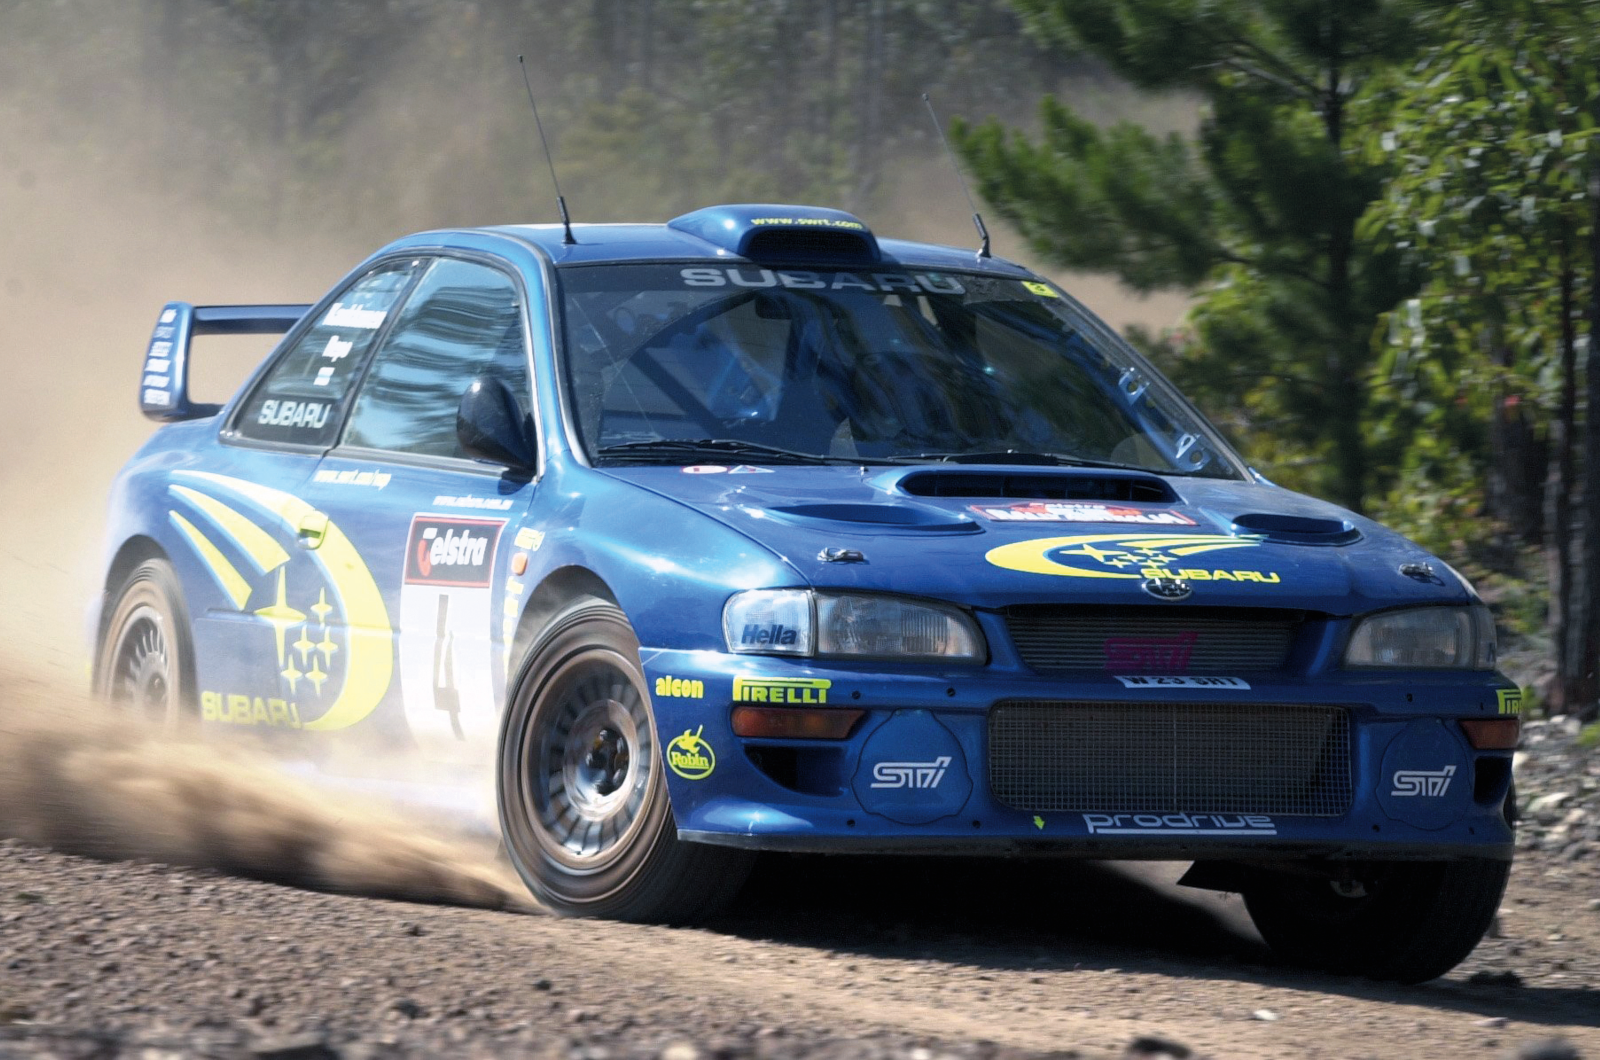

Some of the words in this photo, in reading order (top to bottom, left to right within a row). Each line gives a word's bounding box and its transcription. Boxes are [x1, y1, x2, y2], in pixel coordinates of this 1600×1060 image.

[680, 268, 967, 295] SUBARU
[257, 399, 332, 429] SUBARU
[417, 526, 488, 578] Telstra
[1141, 568, 1280, 583] SUBARU
[741, 624, 797, 645] Hella
[655, 675, 704, 699] alcon
[732, 675, 832, 704] PIRELLI
[201, 690, 303, 730] SUBARU
[671, 751, 710, 768] Robin
[1082, 811, 1275, 834] prodrive
